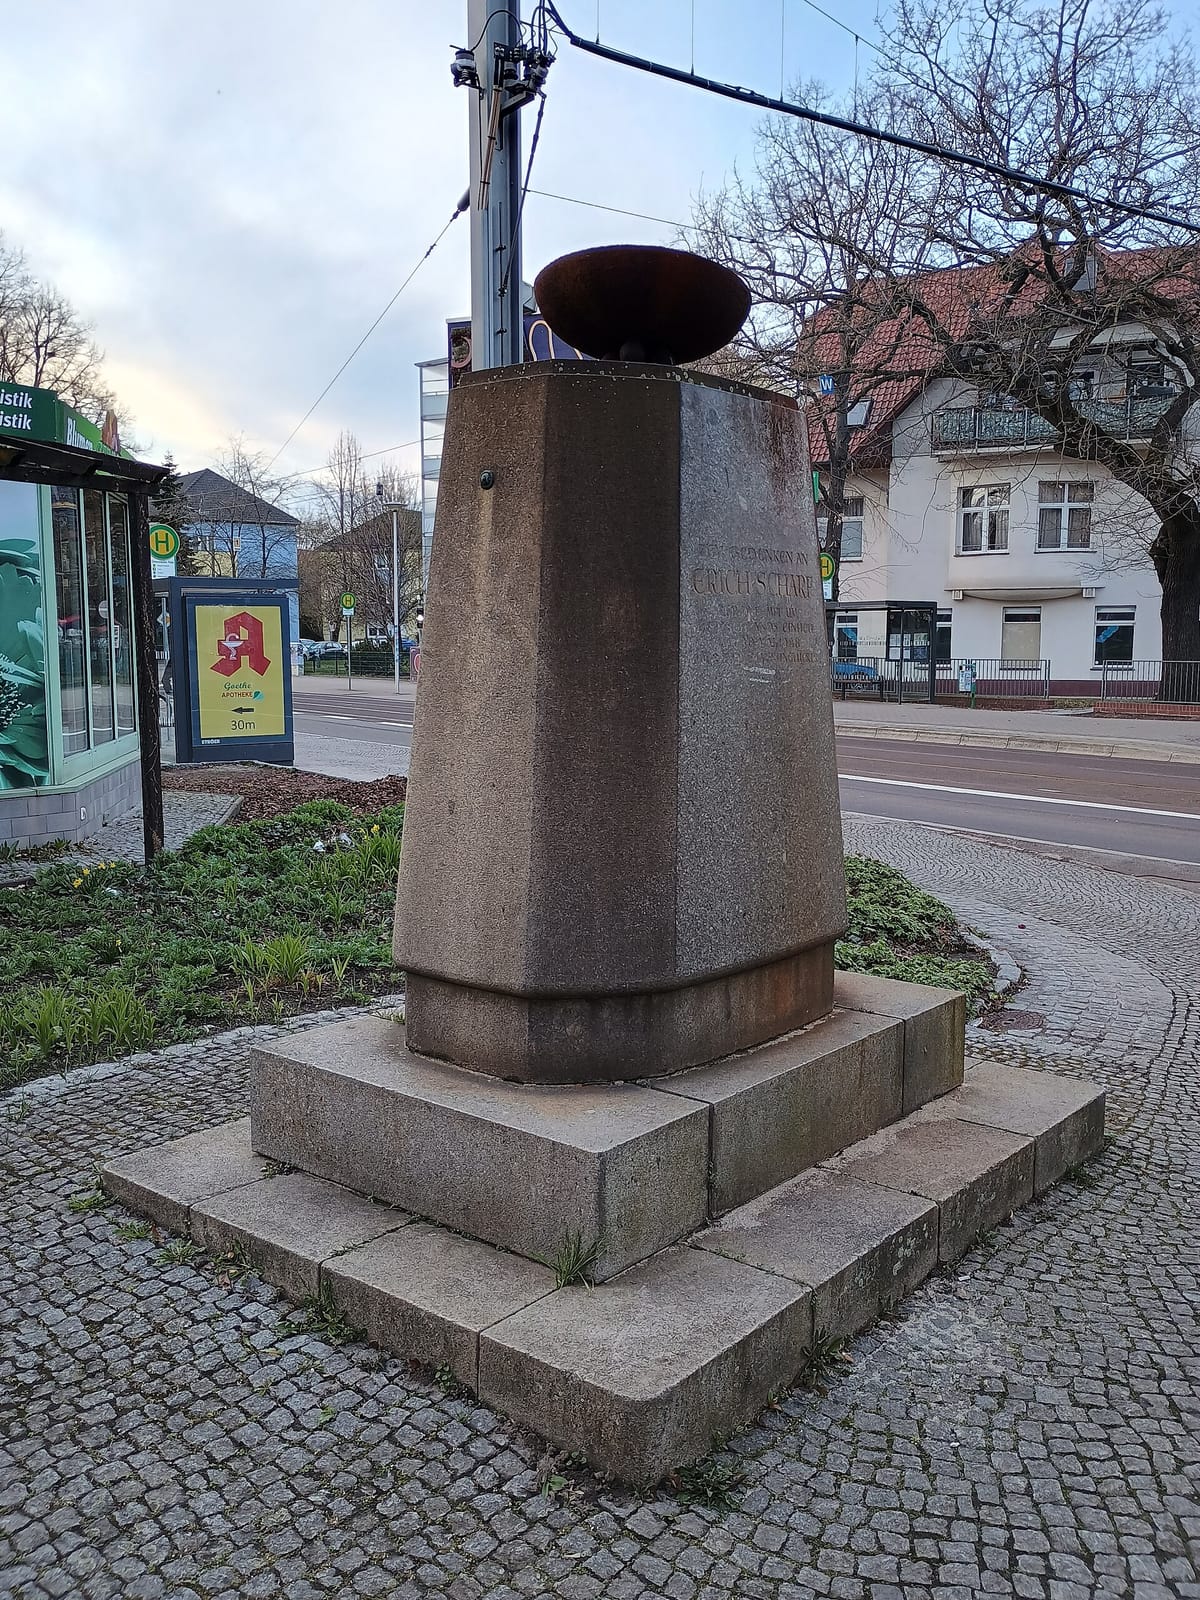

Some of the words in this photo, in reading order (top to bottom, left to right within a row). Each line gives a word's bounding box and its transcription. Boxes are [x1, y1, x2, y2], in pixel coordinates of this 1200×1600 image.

[821, 378, 833, 391] W
[0, 389, 33, 409] istik
[155, 532, 169, 552] H
[692, 567, 751, 596] ERICH
[223, 681, 251, 691] Goethe
[231, 719, 256, 731] 30m
